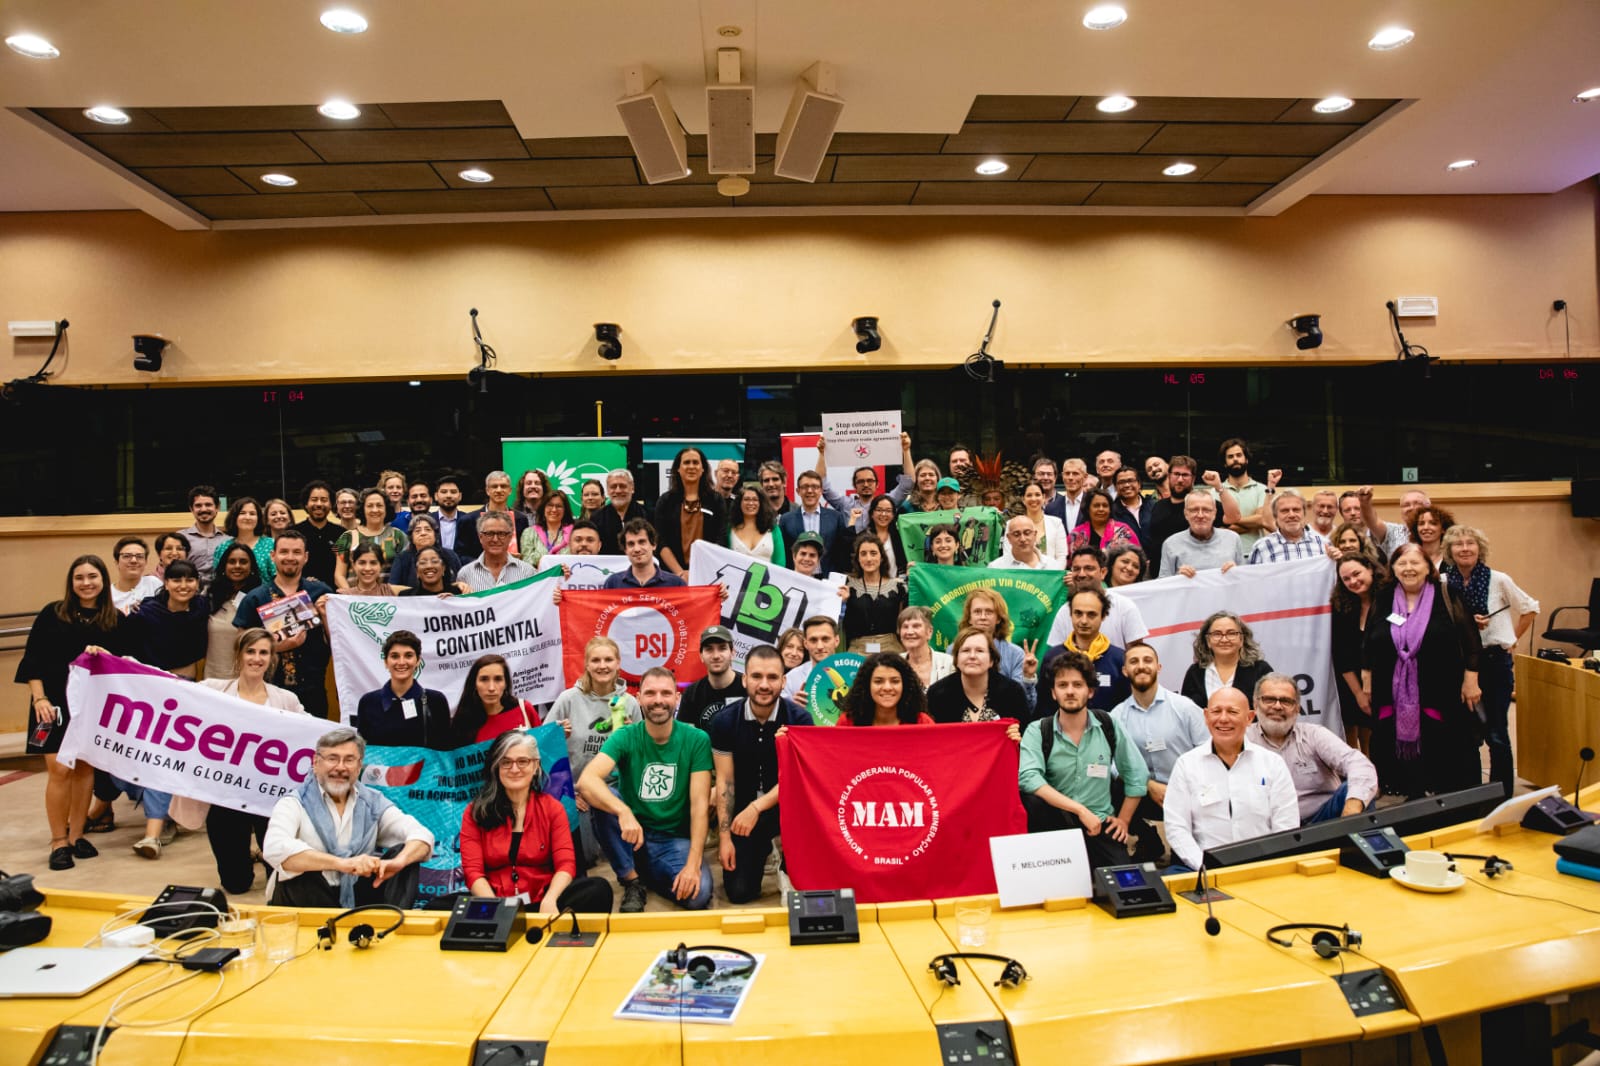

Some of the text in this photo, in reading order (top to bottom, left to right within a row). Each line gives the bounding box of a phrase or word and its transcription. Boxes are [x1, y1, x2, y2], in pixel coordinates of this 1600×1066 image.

[263, 390, 304, 402] IT 04
[1407, 471, 1414, 480] 6
[999, 578, 1013, 587] VIA
[621, 595, 634, 605] DE
[423, 607, 496, 634] JORNADA
[436, 618, 543, 657] CONTINENTAL
[635, 632, 667, 659] PSI
[513, 666, 539, 677] Amigos
[521, 672, 542, 682] Tierra
[94, 734, 295, 798] GEMEINSAM GLOBAL GER
[838, 766, 940, 857] MOVIMENTO PELA SOBERANIA POPULAR NA MINERAÇÃO
[851, 801, 925, 827] MAM
[874, 857, 904, 865] BRASIL
[1021, 857, 1072, 869] MELCHIONNA
